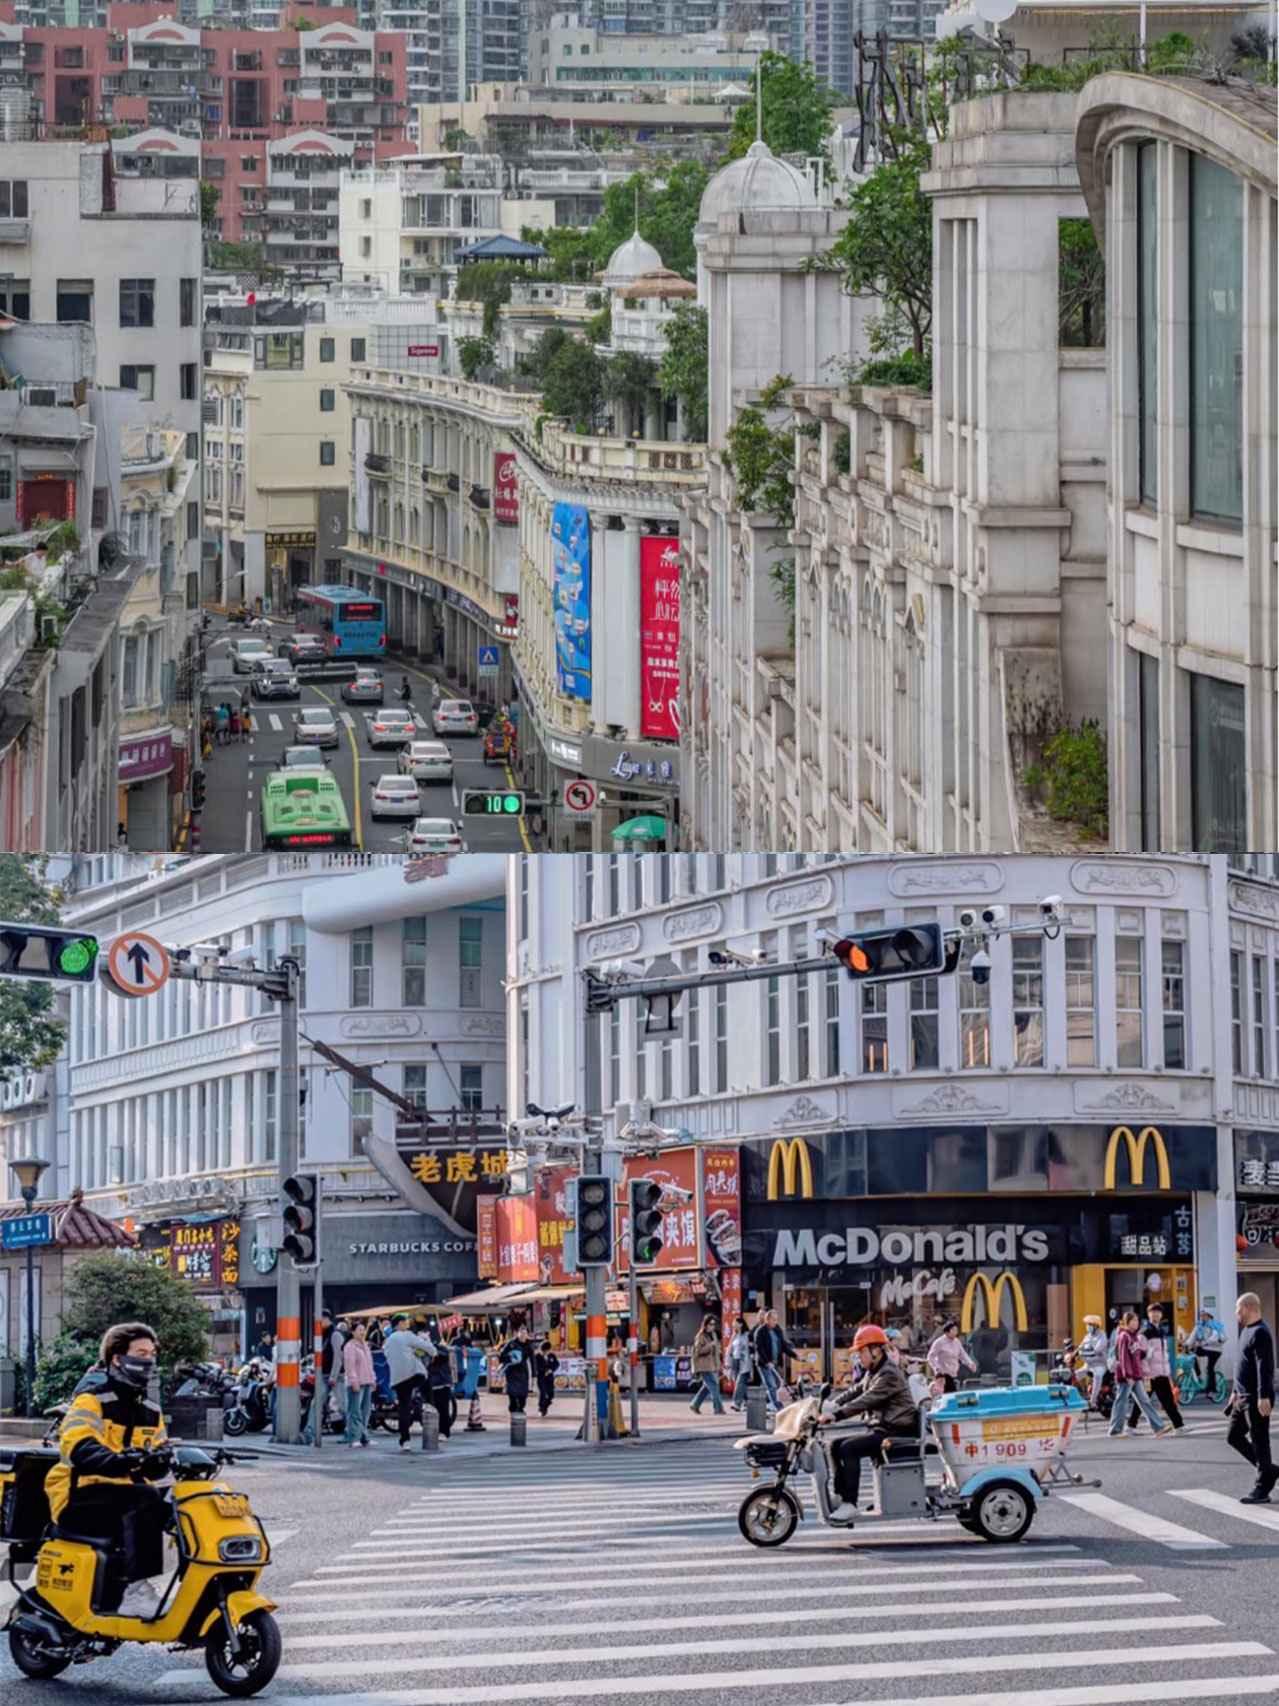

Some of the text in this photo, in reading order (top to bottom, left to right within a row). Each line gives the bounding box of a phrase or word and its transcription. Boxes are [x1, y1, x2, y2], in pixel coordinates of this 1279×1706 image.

[487, 796, 502, 813] 10
[410, 1151, 508, 1183] 老虎城
[1121, 1234, 1167, 1256] 甜品站
[1174, 1205, 1192, 1255] 古茗
[222, 1222, 240, 1283] 沙茶面
[350, 1241, 478, 1255] STARBUCKS COF
[772, 1227, 1049, 1267] McDonald's
